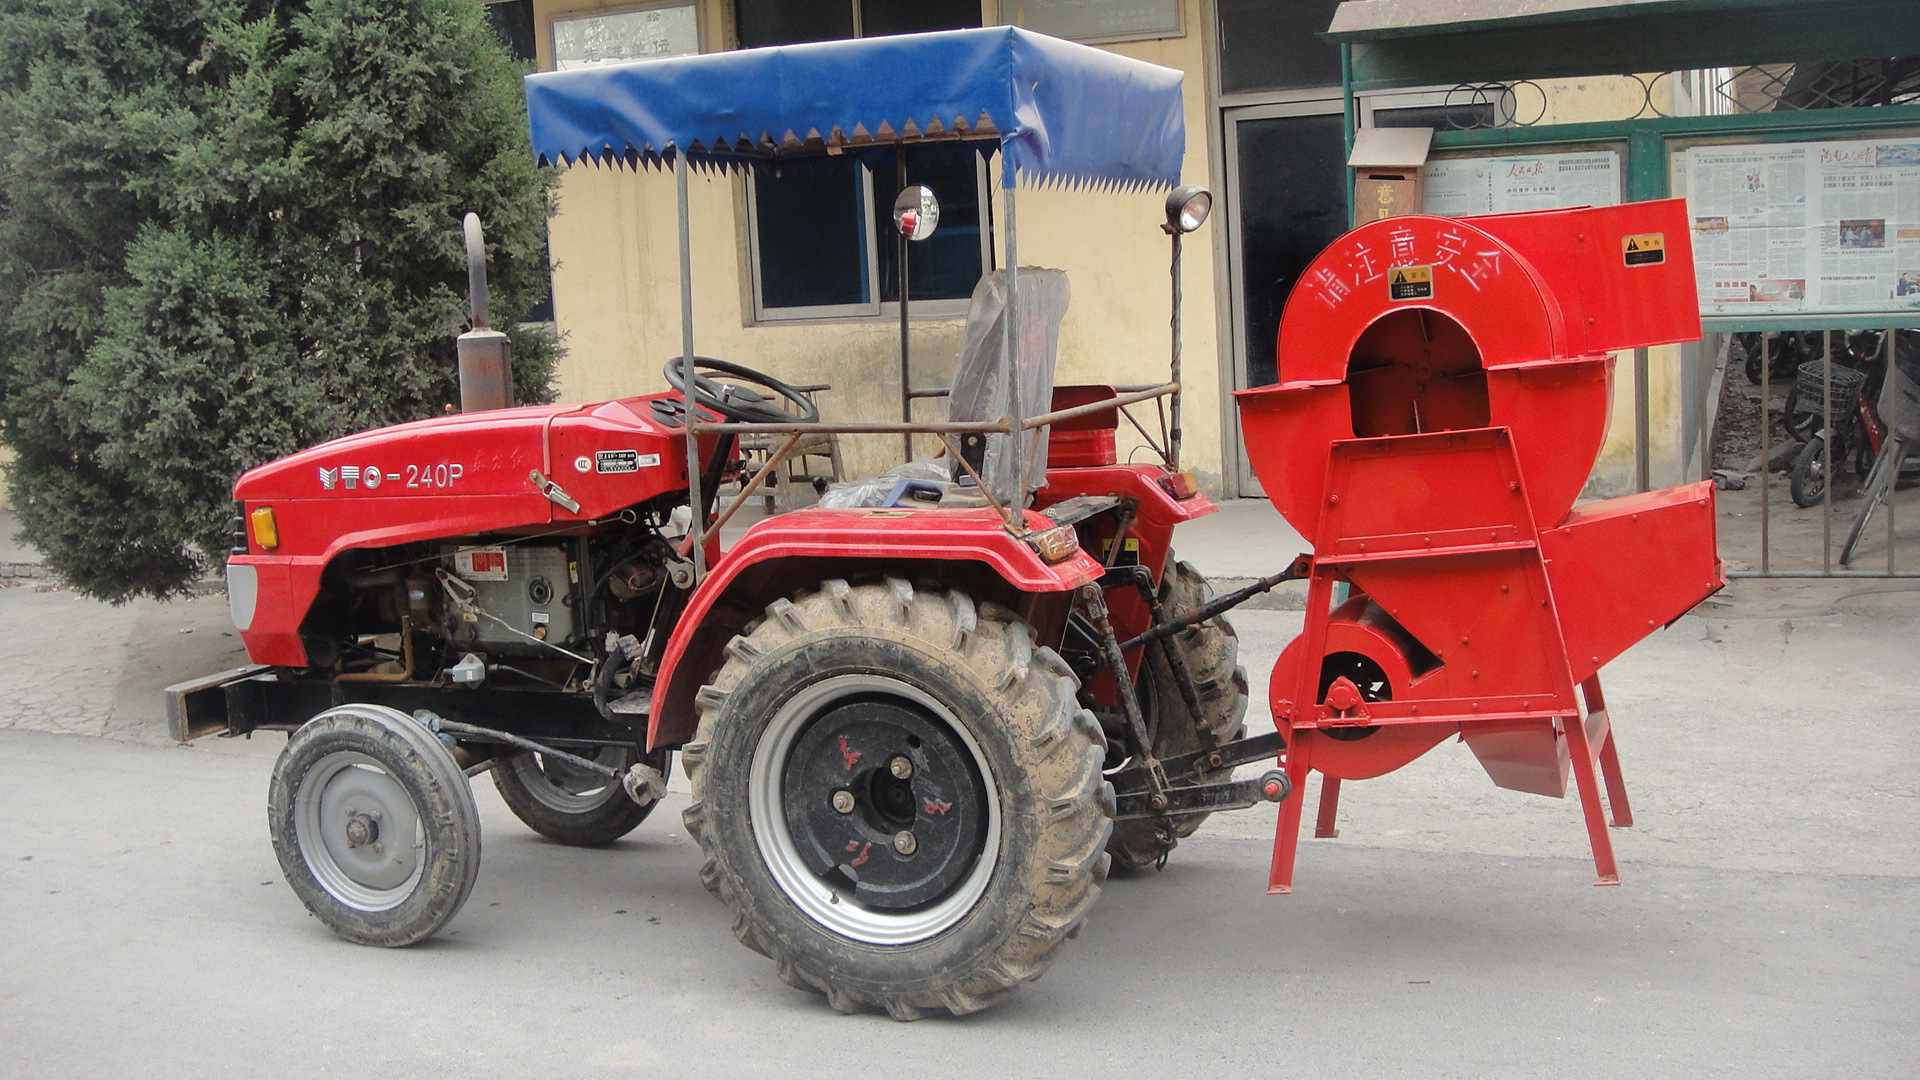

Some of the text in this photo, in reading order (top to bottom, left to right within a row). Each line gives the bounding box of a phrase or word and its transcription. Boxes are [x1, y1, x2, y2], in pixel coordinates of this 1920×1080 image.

[584, 39, 671, 63] 先进单位
[1506, 160, 1545, 178] 人民日报
[319, 463, 464, 490] YTO-240P
